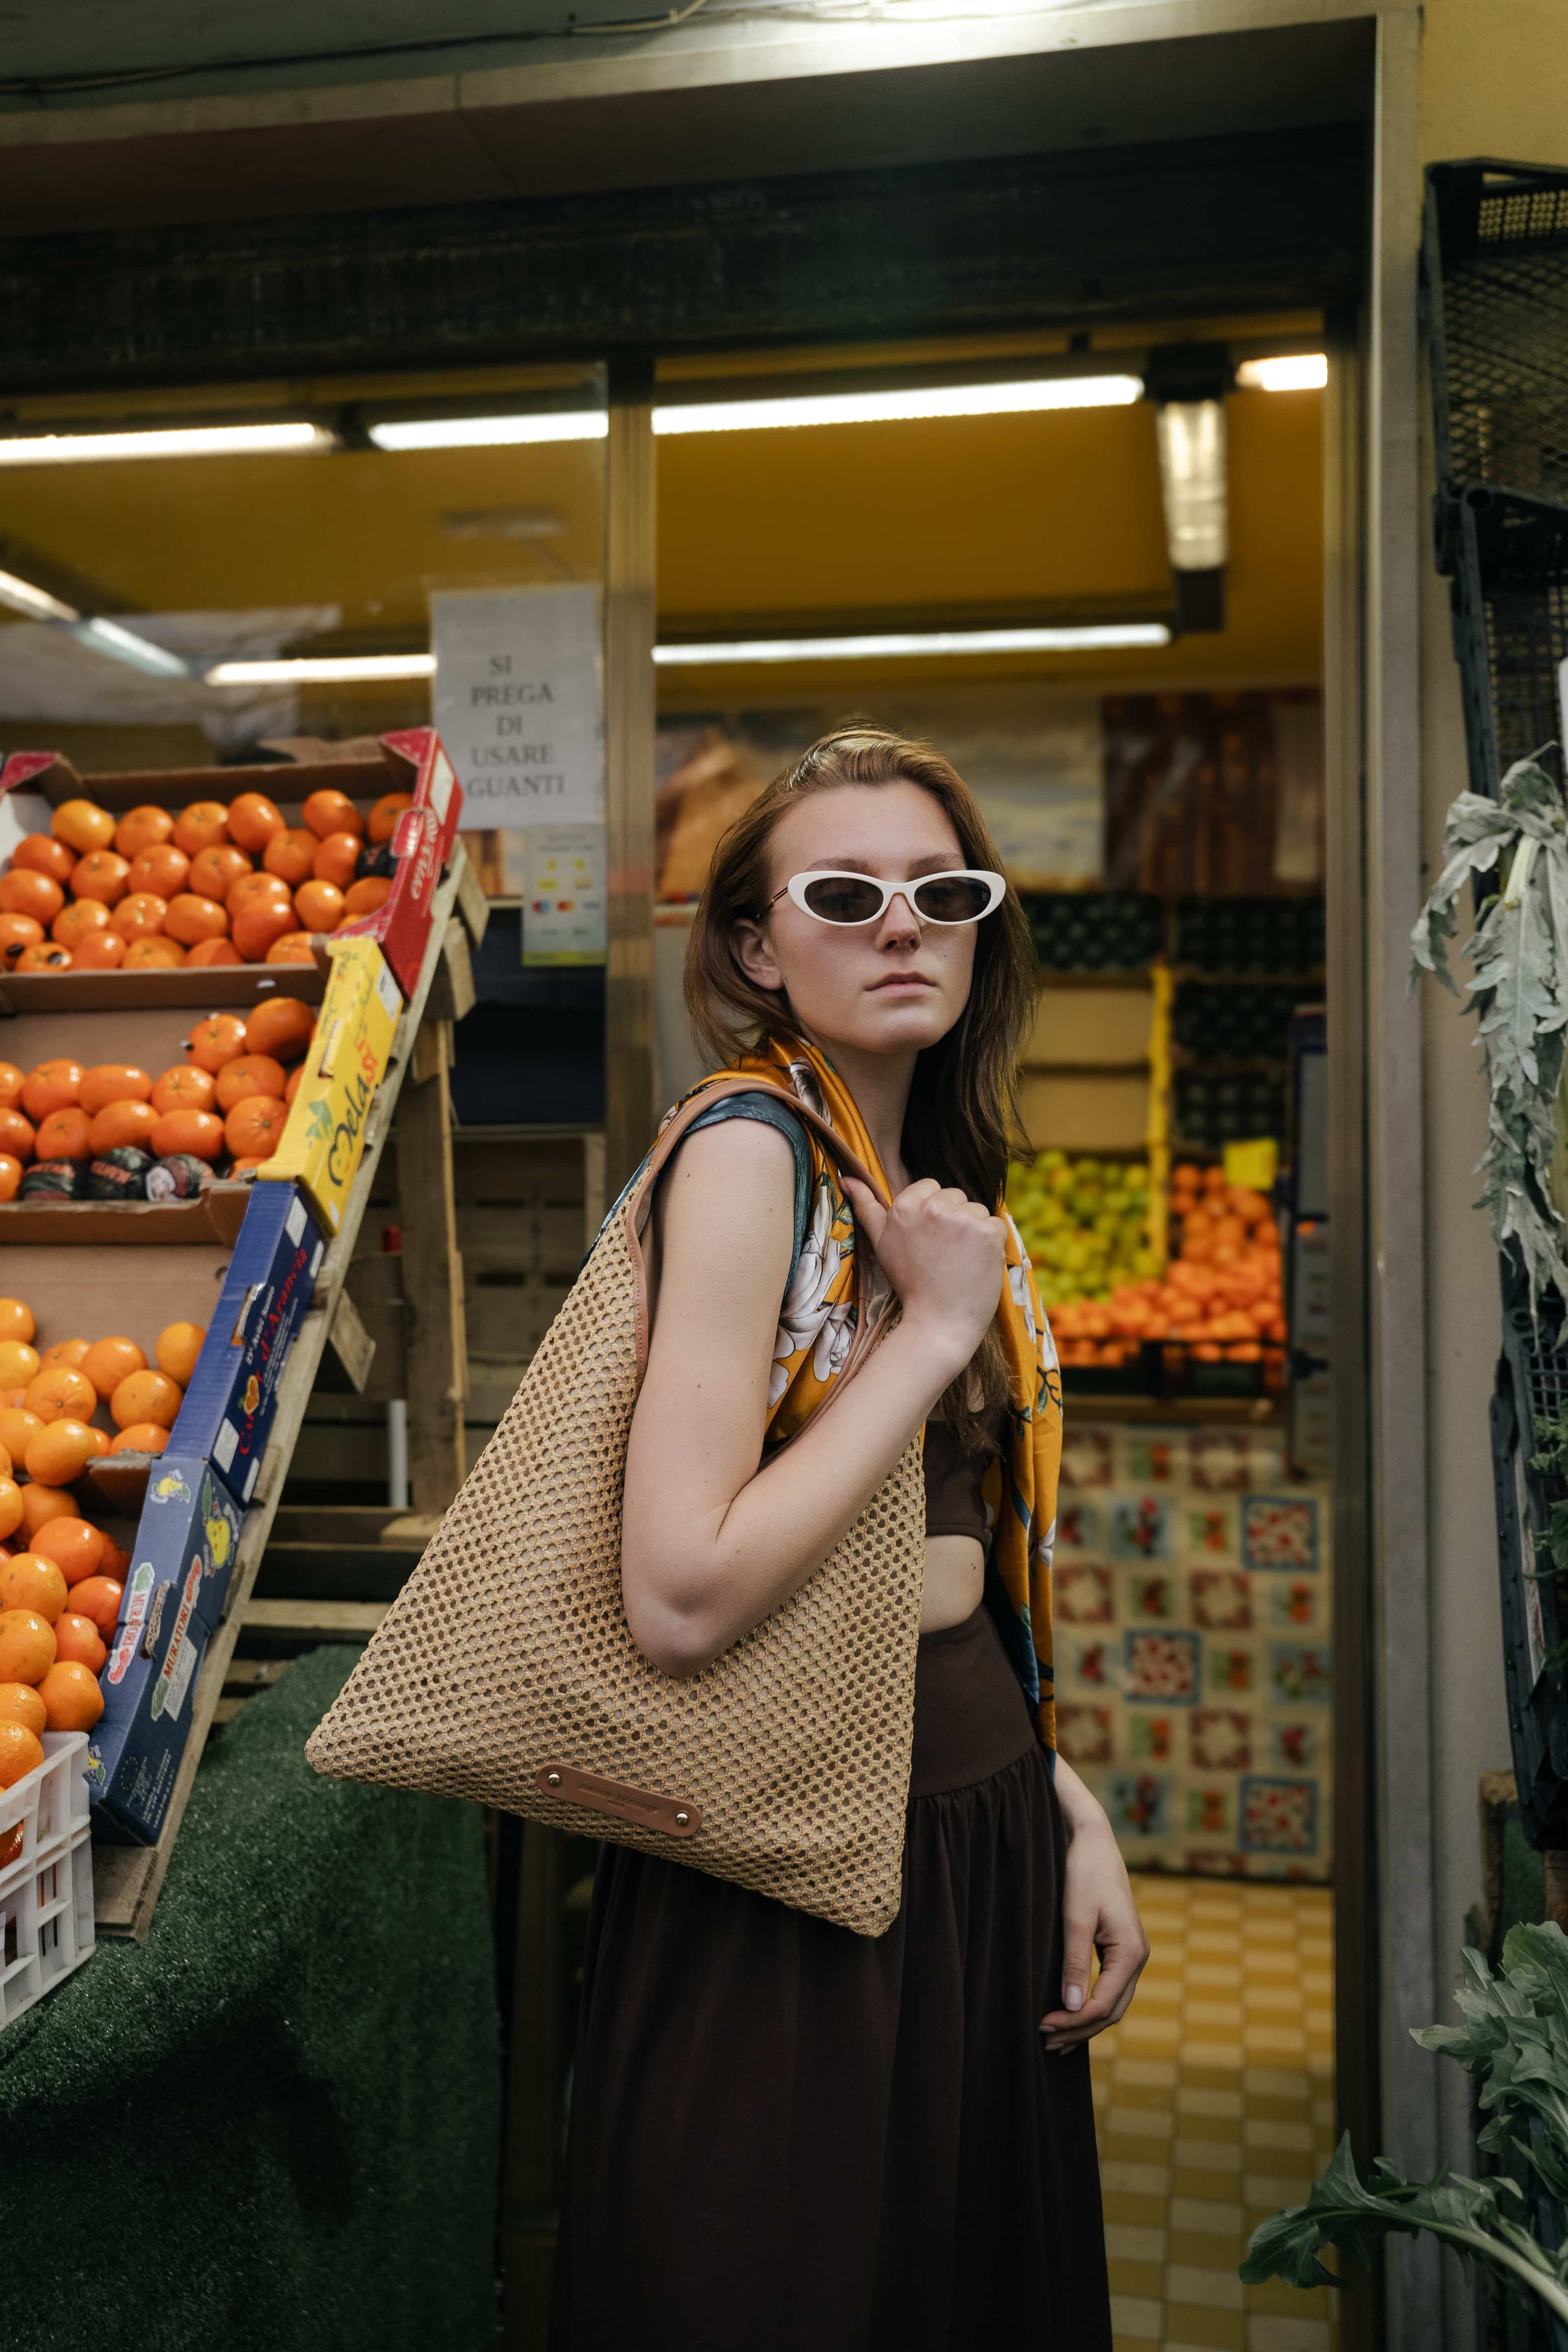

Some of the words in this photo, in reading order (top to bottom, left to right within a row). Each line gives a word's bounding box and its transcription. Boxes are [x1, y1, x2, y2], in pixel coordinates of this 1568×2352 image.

[489, 655, 512, 677] SI
[471, 682, 555, 707] PREGA
[497, 714, 522, 736] DI
[471, 743, 555, 768] USARE
[467, 775, 564, 798] GUANTI
[164, 1602, 190, 1679] MURATORI
